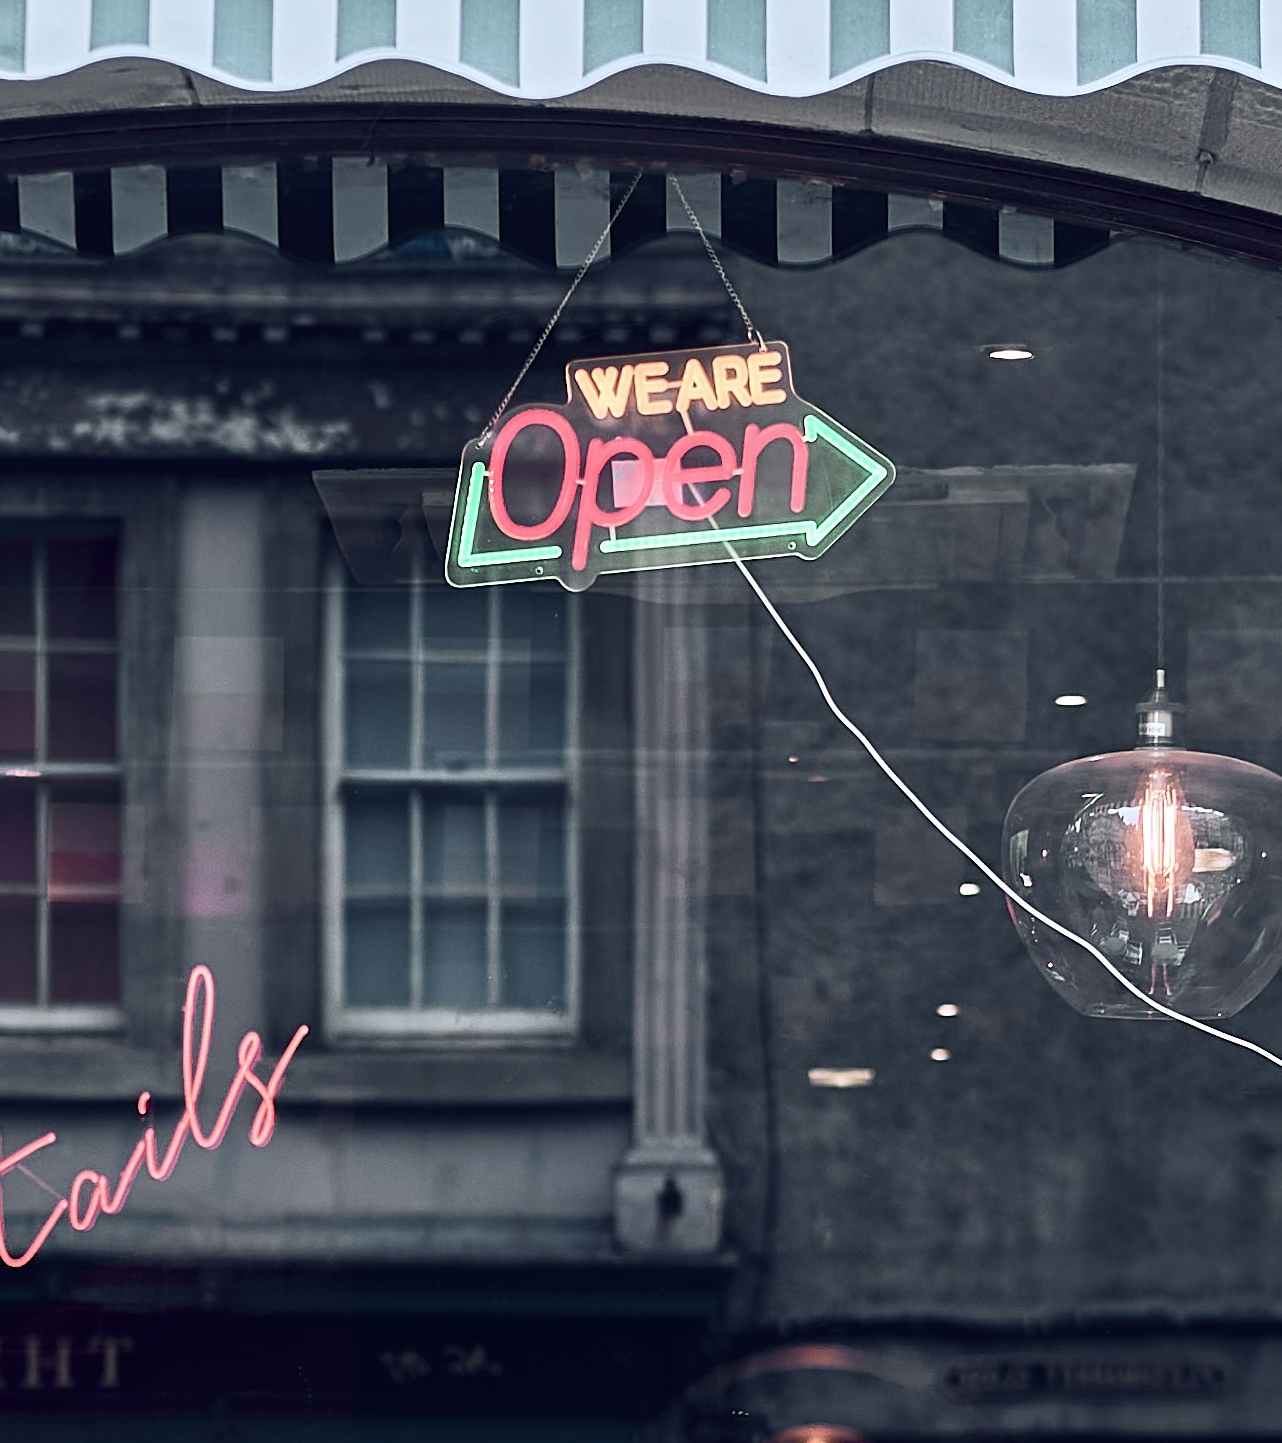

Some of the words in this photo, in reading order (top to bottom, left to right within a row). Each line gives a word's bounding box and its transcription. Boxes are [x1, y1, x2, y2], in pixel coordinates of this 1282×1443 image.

[574, 361, 673, 420] WE
[676, 350, 787, 412] ARE
[489, 406, 809, 572] Open
